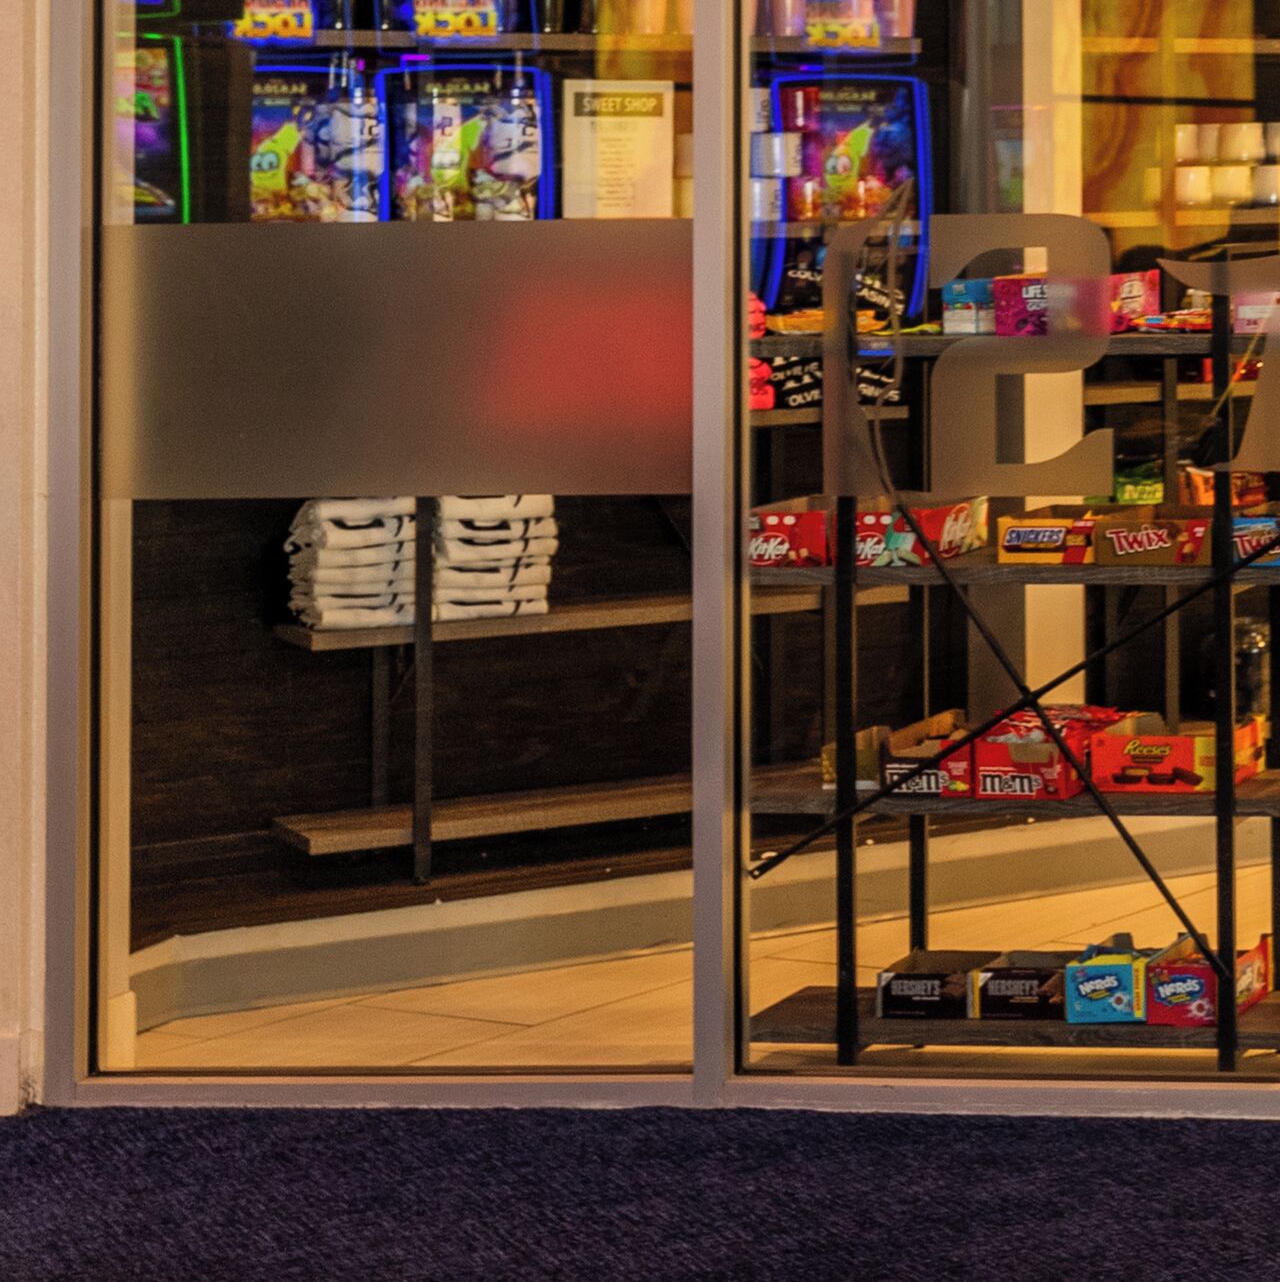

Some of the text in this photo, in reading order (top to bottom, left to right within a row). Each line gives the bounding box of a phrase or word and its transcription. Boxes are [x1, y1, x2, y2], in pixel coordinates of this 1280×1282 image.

[582, 96, 657, 113] SWEET SHOP
[1004, 527, 1064, 547] SNICKERS
[1107, 526, 1171, 556] Twix
